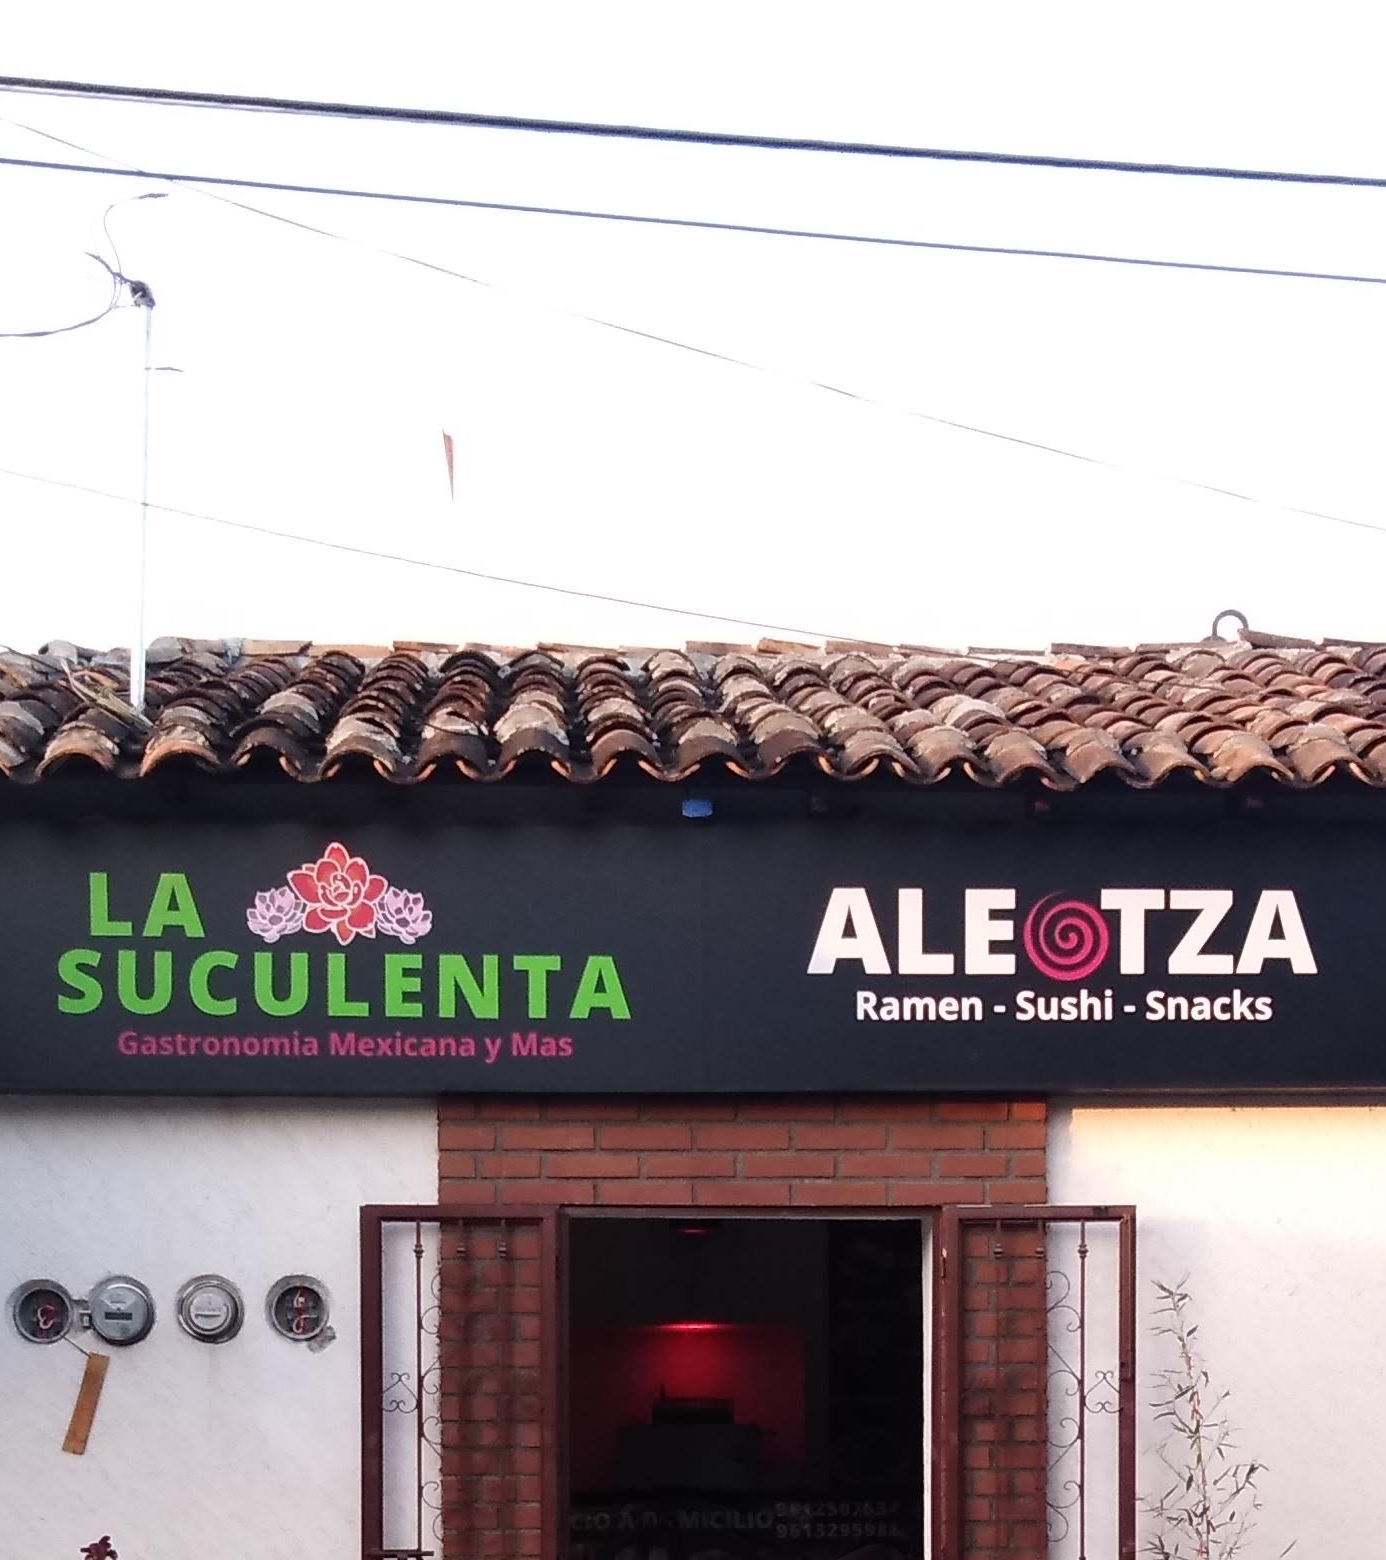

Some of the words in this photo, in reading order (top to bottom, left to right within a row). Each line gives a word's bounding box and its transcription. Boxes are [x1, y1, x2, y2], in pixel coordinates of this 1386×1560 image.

[89, 872, 206, 938] LA
[57, 948, 632, 1021] SUCULENTA
[855, 989, 984, 1022] Ramen
[1014, 987, 1114, 1022] Sushi
[1144, 987, 1274, 1022] Snacks
[117, 1030, 321, 1058] Gastronomia
[327, 1030, 479, 1058] Mexicana
[484, 1038, 504, 1064] y
[509, 1030, 575, 1058] Mas
